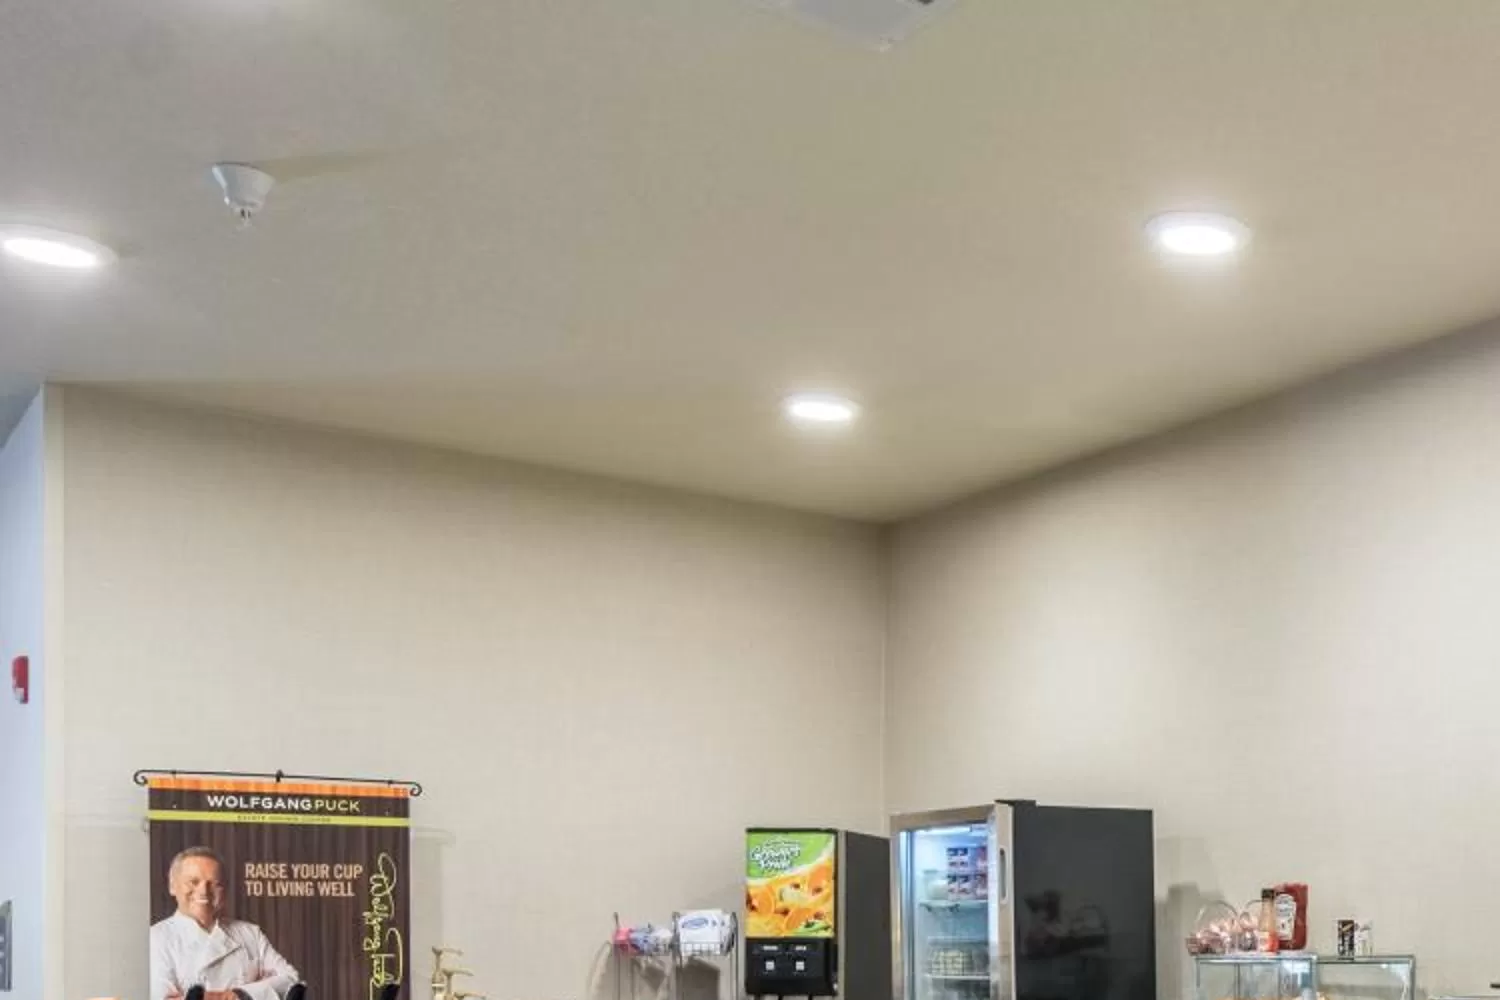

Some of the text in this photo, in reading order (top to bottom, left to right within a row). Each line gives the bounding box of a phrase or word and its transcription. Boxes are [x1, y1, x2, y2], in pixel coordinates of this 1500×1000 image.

[245, 863, 363, 879] RAISE YOUR CUP
[246, 881, 355, 897] TO LIVING WELL
